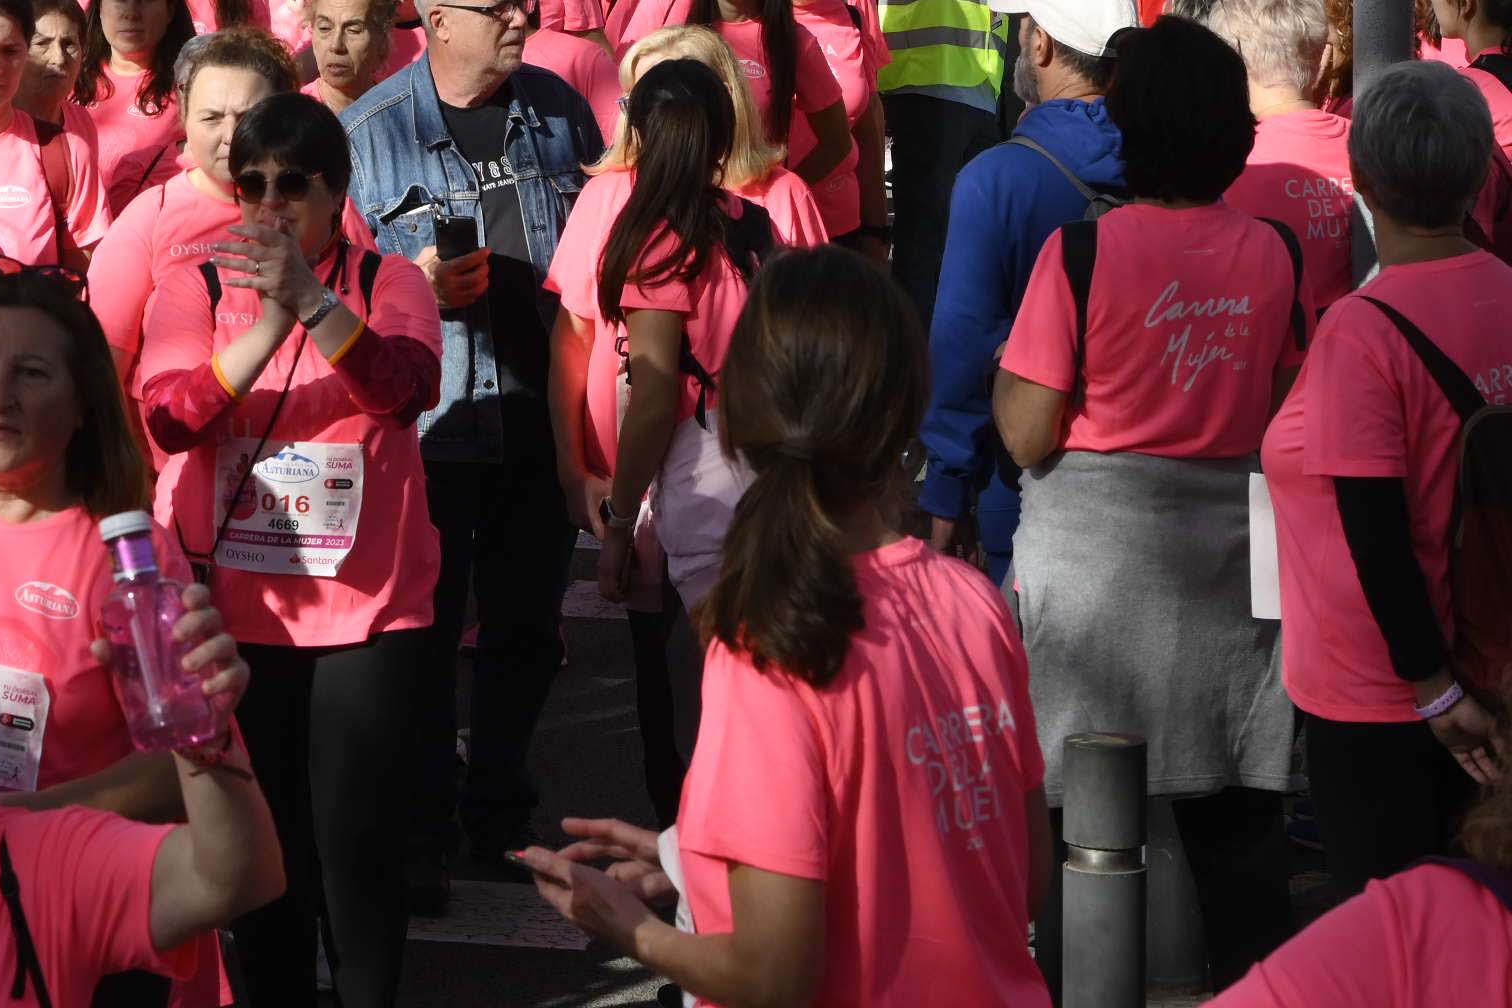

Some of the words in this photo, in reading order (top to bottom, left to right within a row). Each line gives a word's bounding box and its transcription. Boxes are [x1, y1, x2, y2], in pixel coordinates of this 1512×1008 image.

[488, 161, 501, 178] &
[1285, 177, 1353, 198] CARRE
[1144, 280, 1255, 328] Carrera
[1160, 323, 1241, 392] Mujer
[262, 464, 315, 478] ASTURIANA
[326, 461, 353, 471] SUMA
[262, 494, 310, 513] 016
[230, 532, 265, 543] CARRERA
[294, 537, 324, 545] MUJER
[325, 537, 345, 546] 2023
[226, 549, 265, 563] OYSHO
[20, 589, 76, 614] ASTURIANA
[3, 690, 37, 706] SUMA
